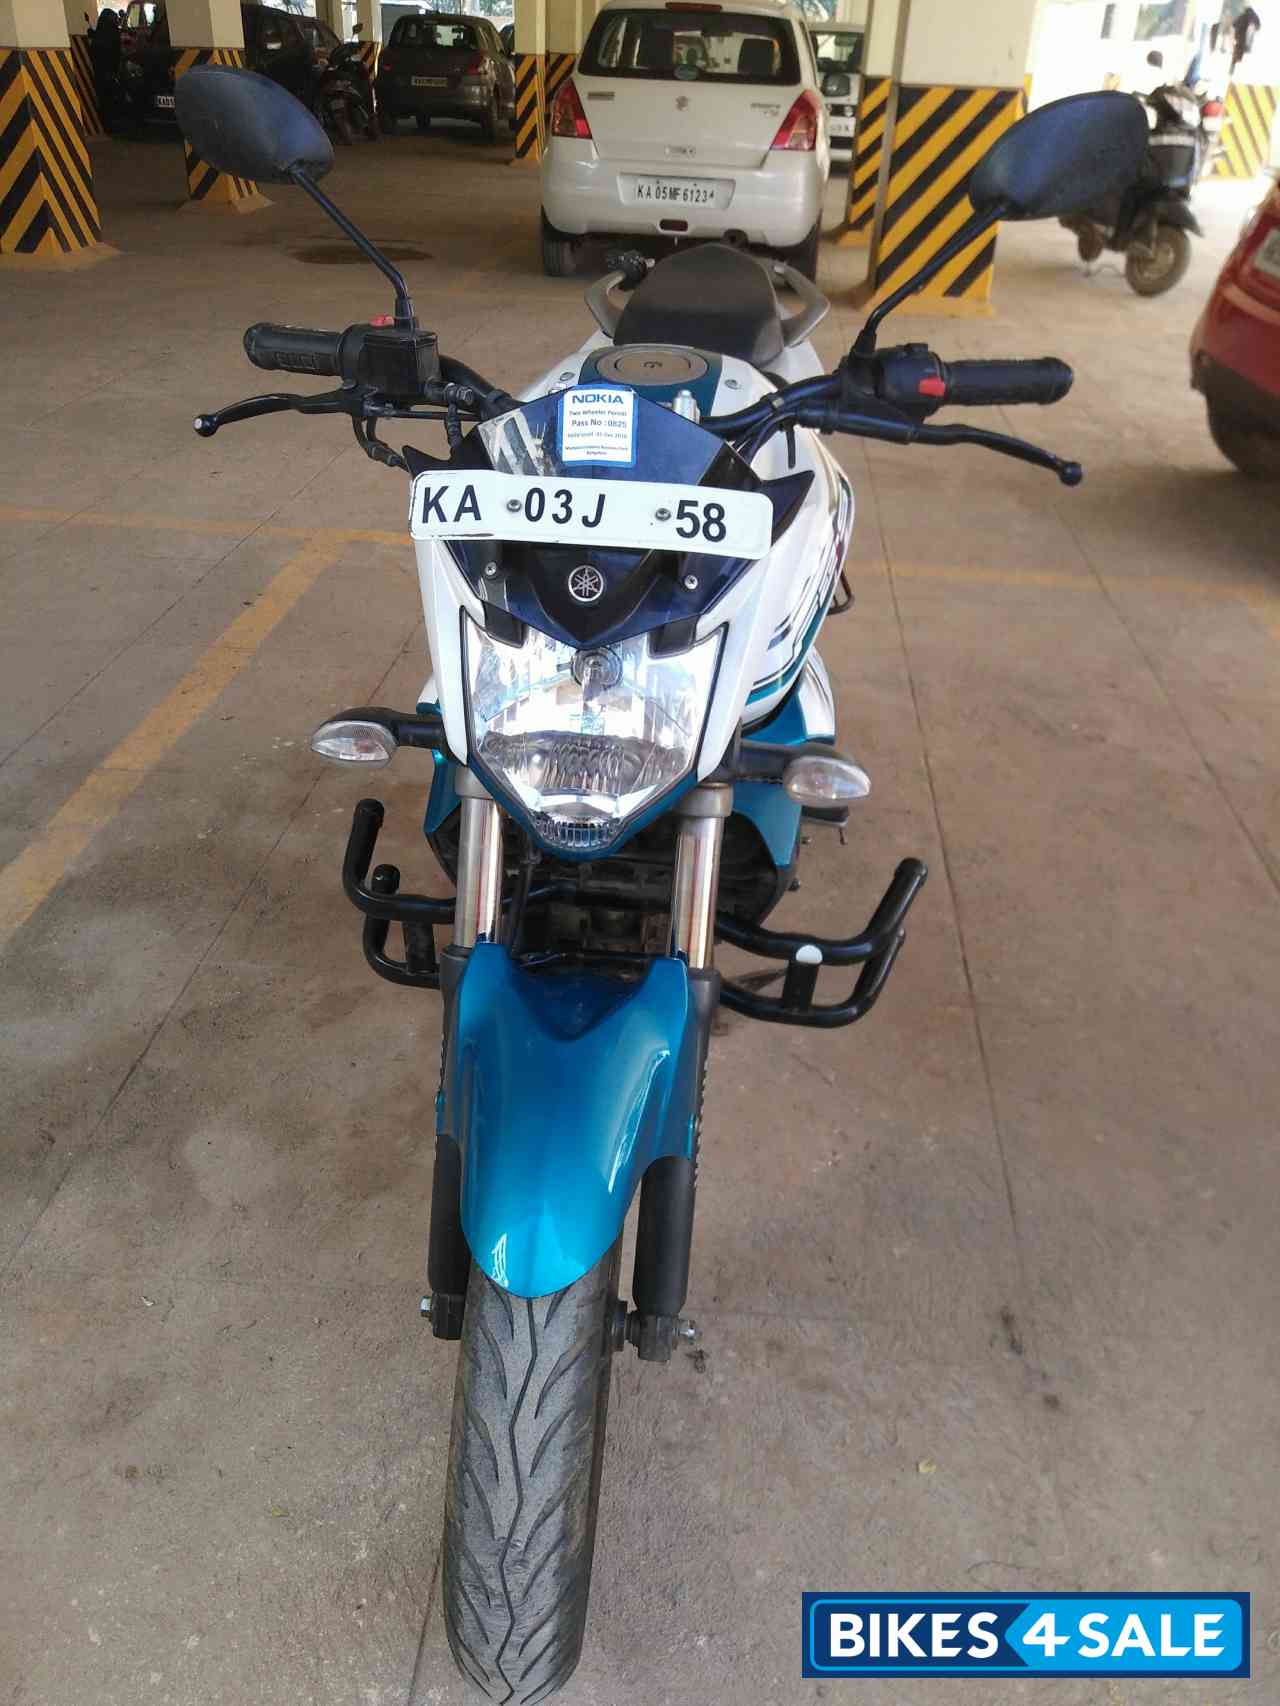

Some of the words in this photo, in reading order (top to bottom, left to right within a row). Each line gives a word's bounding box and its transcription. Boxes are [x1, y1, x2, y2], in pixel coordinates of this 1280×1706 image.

[637, 184, 652, 199] KA
[572, 393, 624, 405] NOKIA
[571, 419, 589, 428] Pass
[590, 418, 602, 427] No
[421, 484, 483, 525] KA
[675, 499, 727, 543] 58
